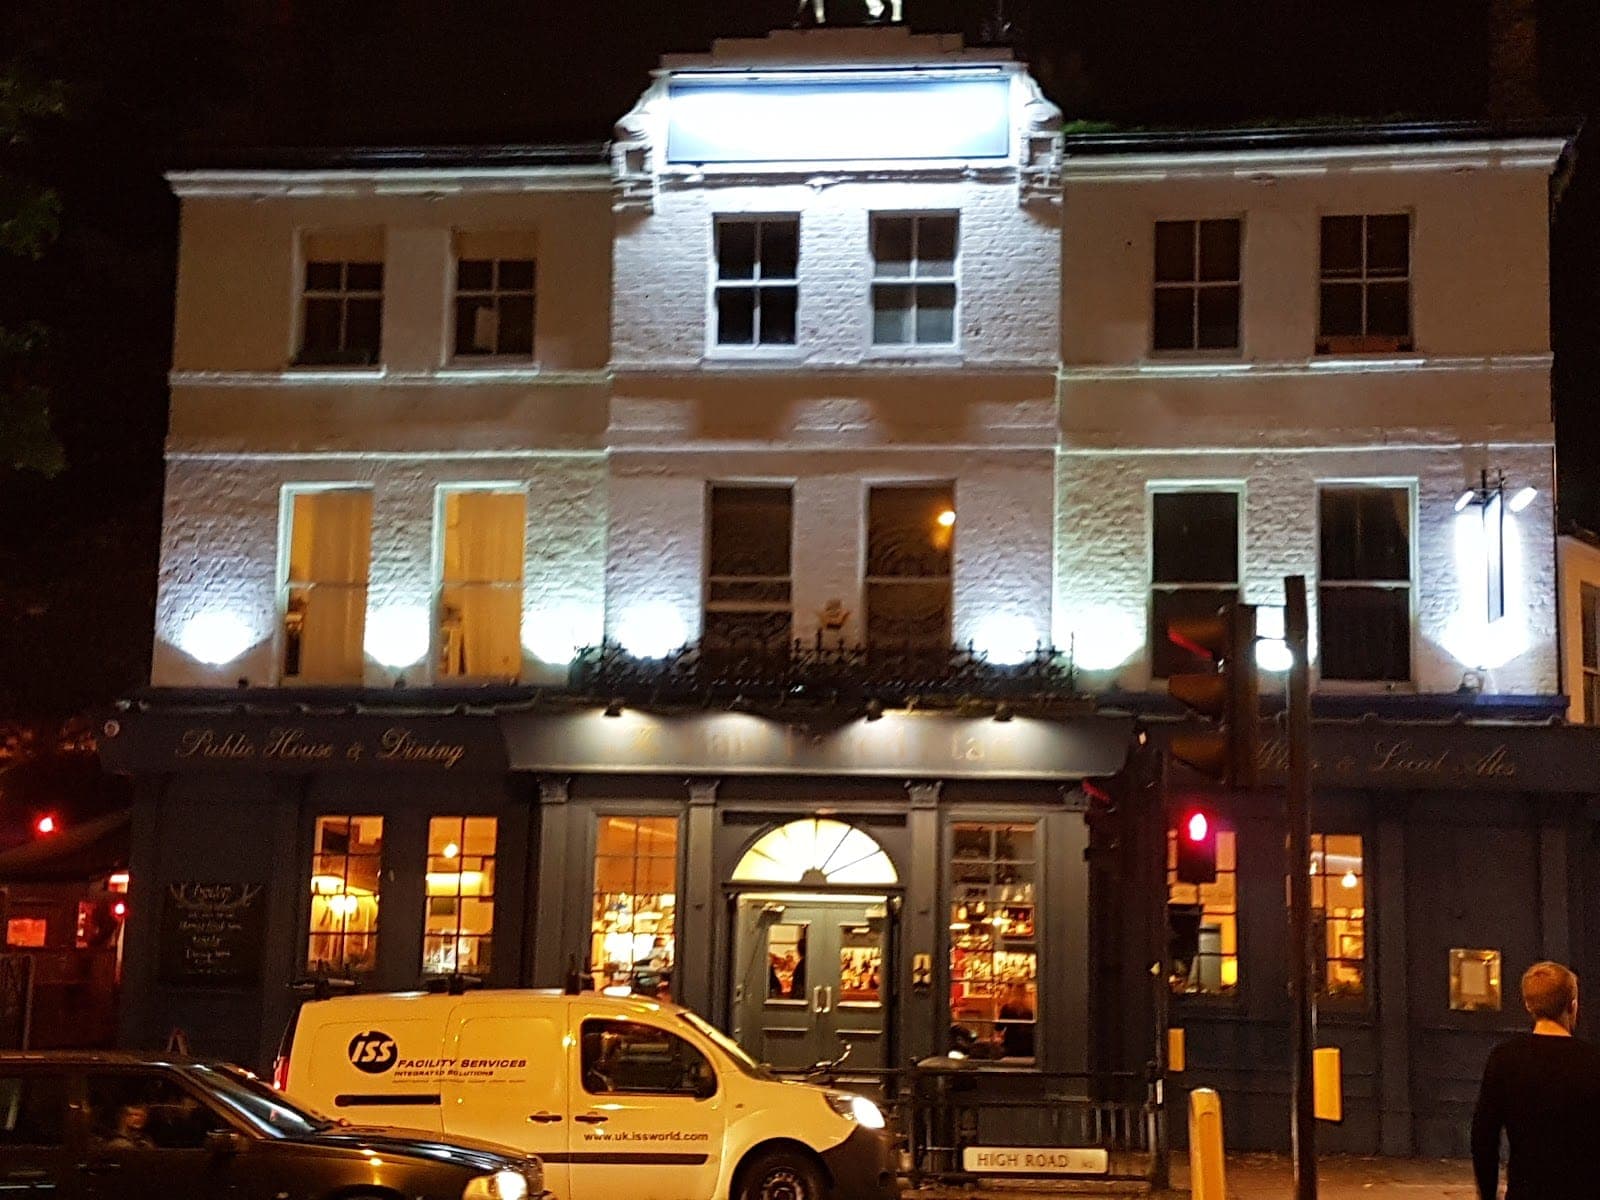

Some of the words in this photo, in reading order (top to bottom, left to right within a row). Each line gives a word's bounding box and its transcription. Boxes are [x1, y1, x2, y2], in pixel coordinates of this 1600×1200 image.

[175, 728, 254, 760] Public
[263, 726, 333, 760] House
[347, 742, 363, 761] &
[377, 727, 465, 769] Dining
[397, 1059, 457, 1069] FACILITY
[460, 1059, 527, 1068] SERVICES
[447, 1069, 494, 1077] SOLUTIONS
[583, 1131, 709, 1141] www.uk.issworld.com
[977, 1153, 1019, 1167] HIGH
[1025, 1153, 1069, 1168] ROAD
